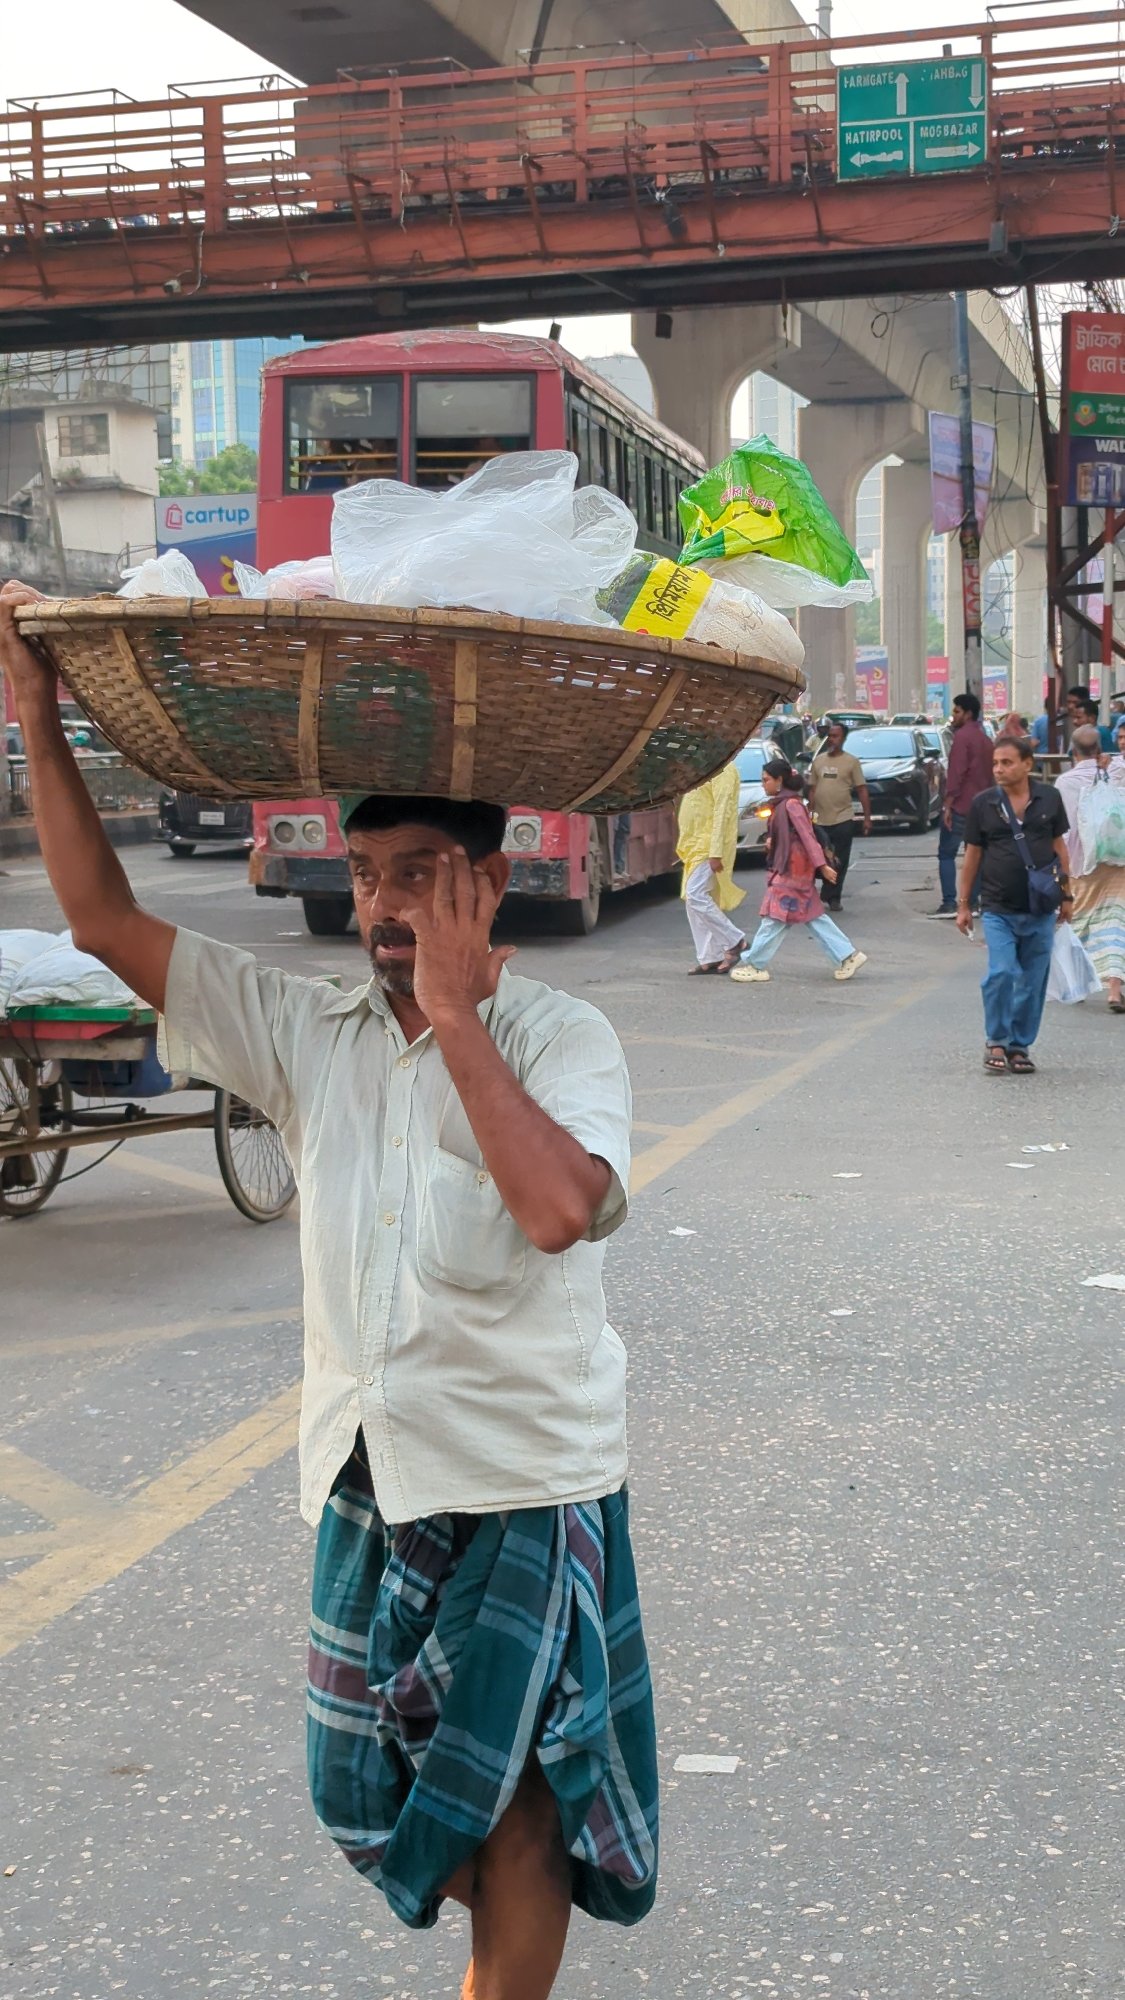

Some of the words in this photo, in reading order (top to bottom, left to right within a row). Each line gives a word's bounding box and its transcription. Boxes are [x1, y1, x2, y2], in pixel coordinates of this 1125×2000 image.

[921, 66, 968, 81] AHBG
[845, 128, 903, 144] HATIRPOOL
[920, 123, 978, 138] MOGBAZAR
[1076, 324, 1122, 350] ট্রাফিক
[1087, 356, 1117, 373] মেনে
[1095, 439, 1125, 453] WAL
[185, 507, 250, 526] cartup
[645, 567, 695, 622] প্রিমিয়াম
